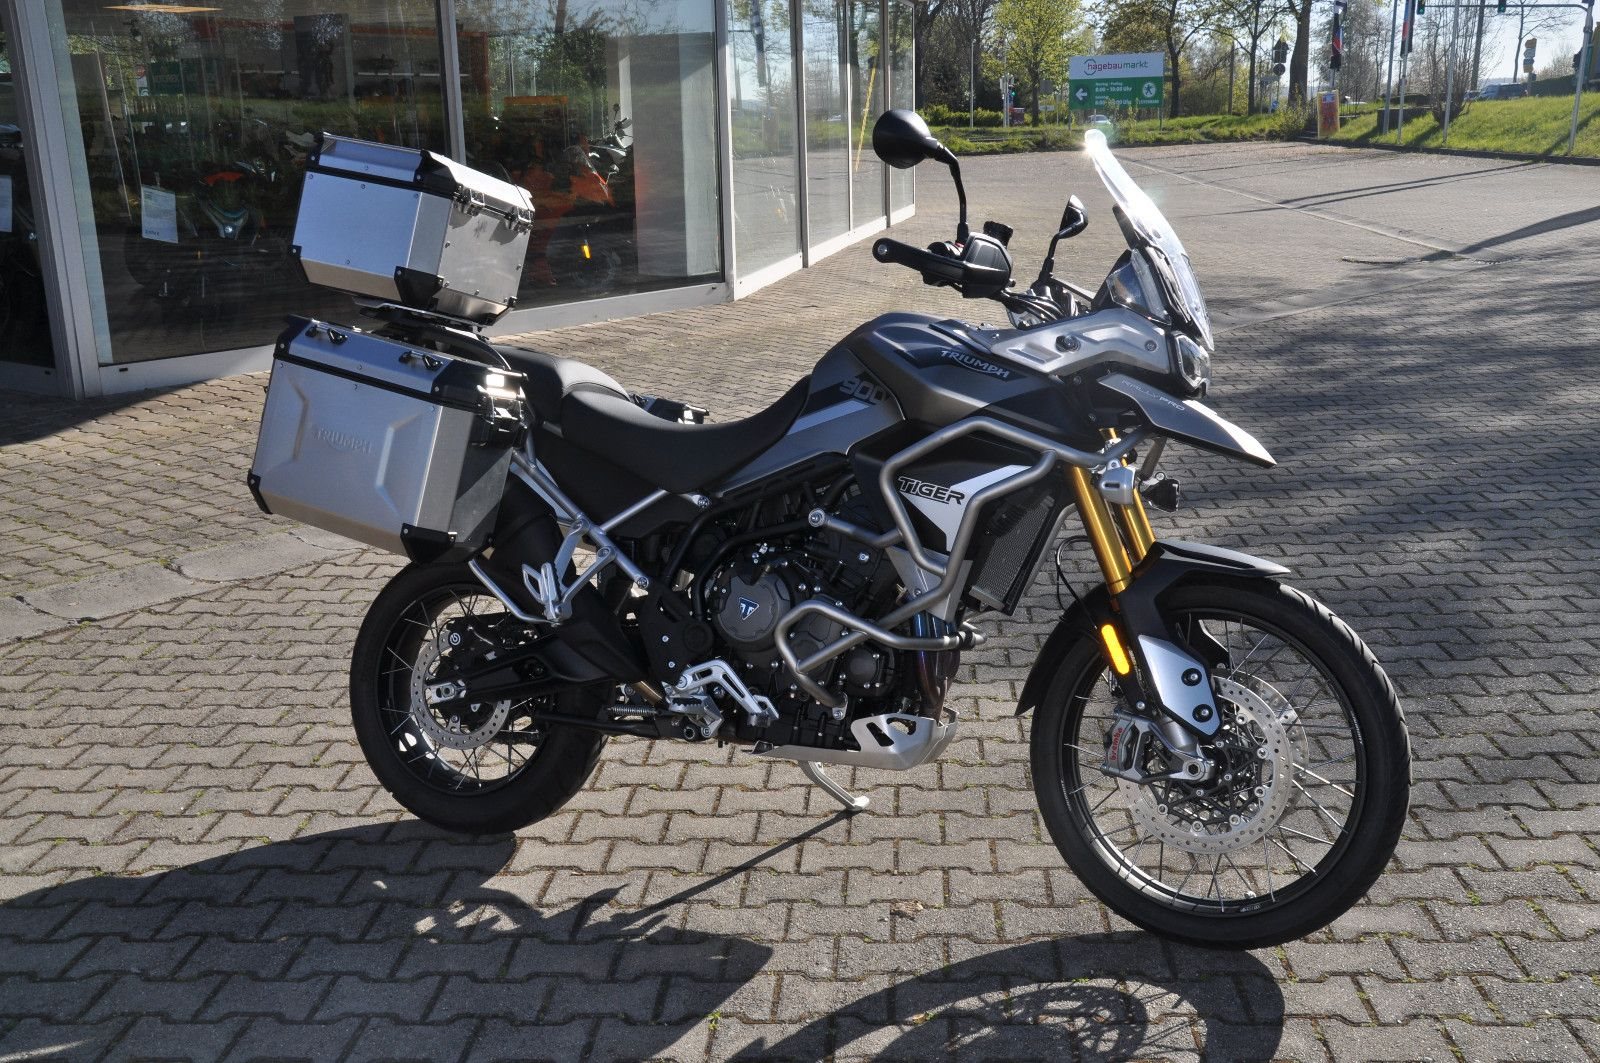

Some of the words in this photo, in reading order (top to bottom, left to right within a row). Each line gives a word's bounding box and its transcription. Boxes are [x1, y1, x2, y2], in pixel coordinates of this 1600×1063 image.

[941, 350, 1010, 378] TRIUMPH
[839, 380, 887, 404] 900
[898, 476, 966, 505] TIGER
